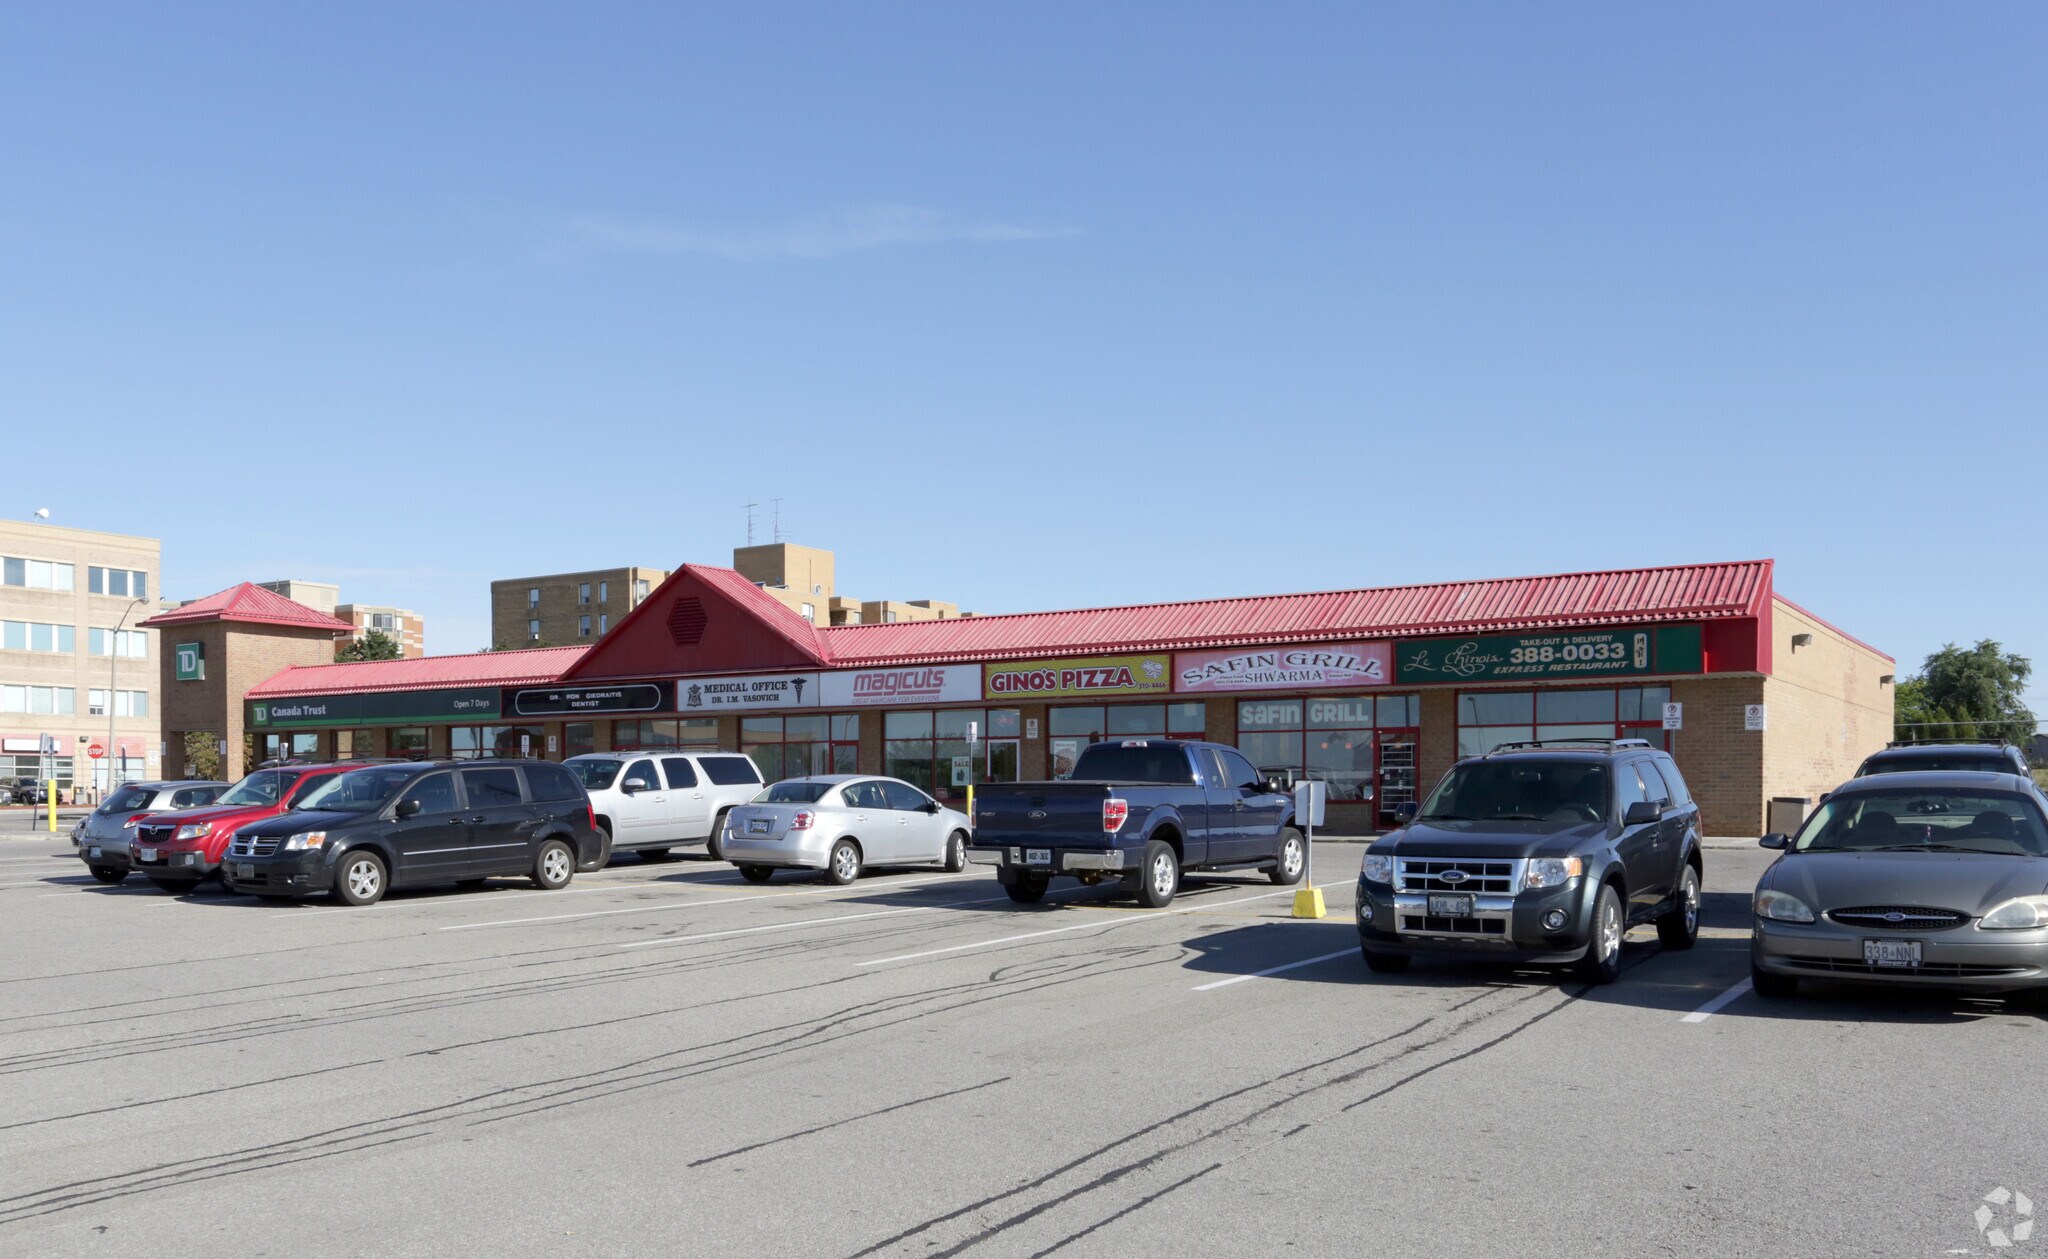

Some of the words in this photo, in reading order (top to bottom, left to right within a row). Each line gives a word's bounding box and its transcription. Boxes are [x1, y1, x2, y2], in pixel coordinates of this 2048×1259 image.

[1519, 637, 1561, 646] TAKE-OUT
[1562, 637, 1569, 645] &
[1572, 634, 1613, 644] DELIVERY
[1441, 642, 1504, 677] Chinois
[1509, 643, 1626, 664] 388-0033
[178, 650, 197, 673] TD
[1183, 653, 1276, 684] SAFIN
[1285, 652, 1382, 677] GRILL
[1492, 664, 1544, 674] EXPRESS
[1548, 660, 1629, 672] RESTAURANT
[853, 668, 945, 696] magicuts
[991, 668, 1057, 694] GINO'S
[1060, 666, 1137, 691] PIZZA
[1244, 669, 1324, 684] SHWARMA
[704, 683, 748, 694] MEDICAL
[751, 680, 788, 692] OFFICE
[585, 691, 622, 699] GIEDRAITIS
[711, 696, 724, 704] DR.
[743, 693, 780, 703] VASOVICH
[453, 700, 470, 709] Open
[475, 699, 490, 709] Days
[571, 700, 600, 708] DENTIST
[253, 707, 267, 721] TD
[271, 705, 302, 717] Canada
[302, 704, 327, 716] Trust
[1310, 703, 1369, 724] GRILL
[88, 747, 103, 755] STOP
[1866, 945, 1889, 959] 338
[1895, 946, 1920, 960] NNL
